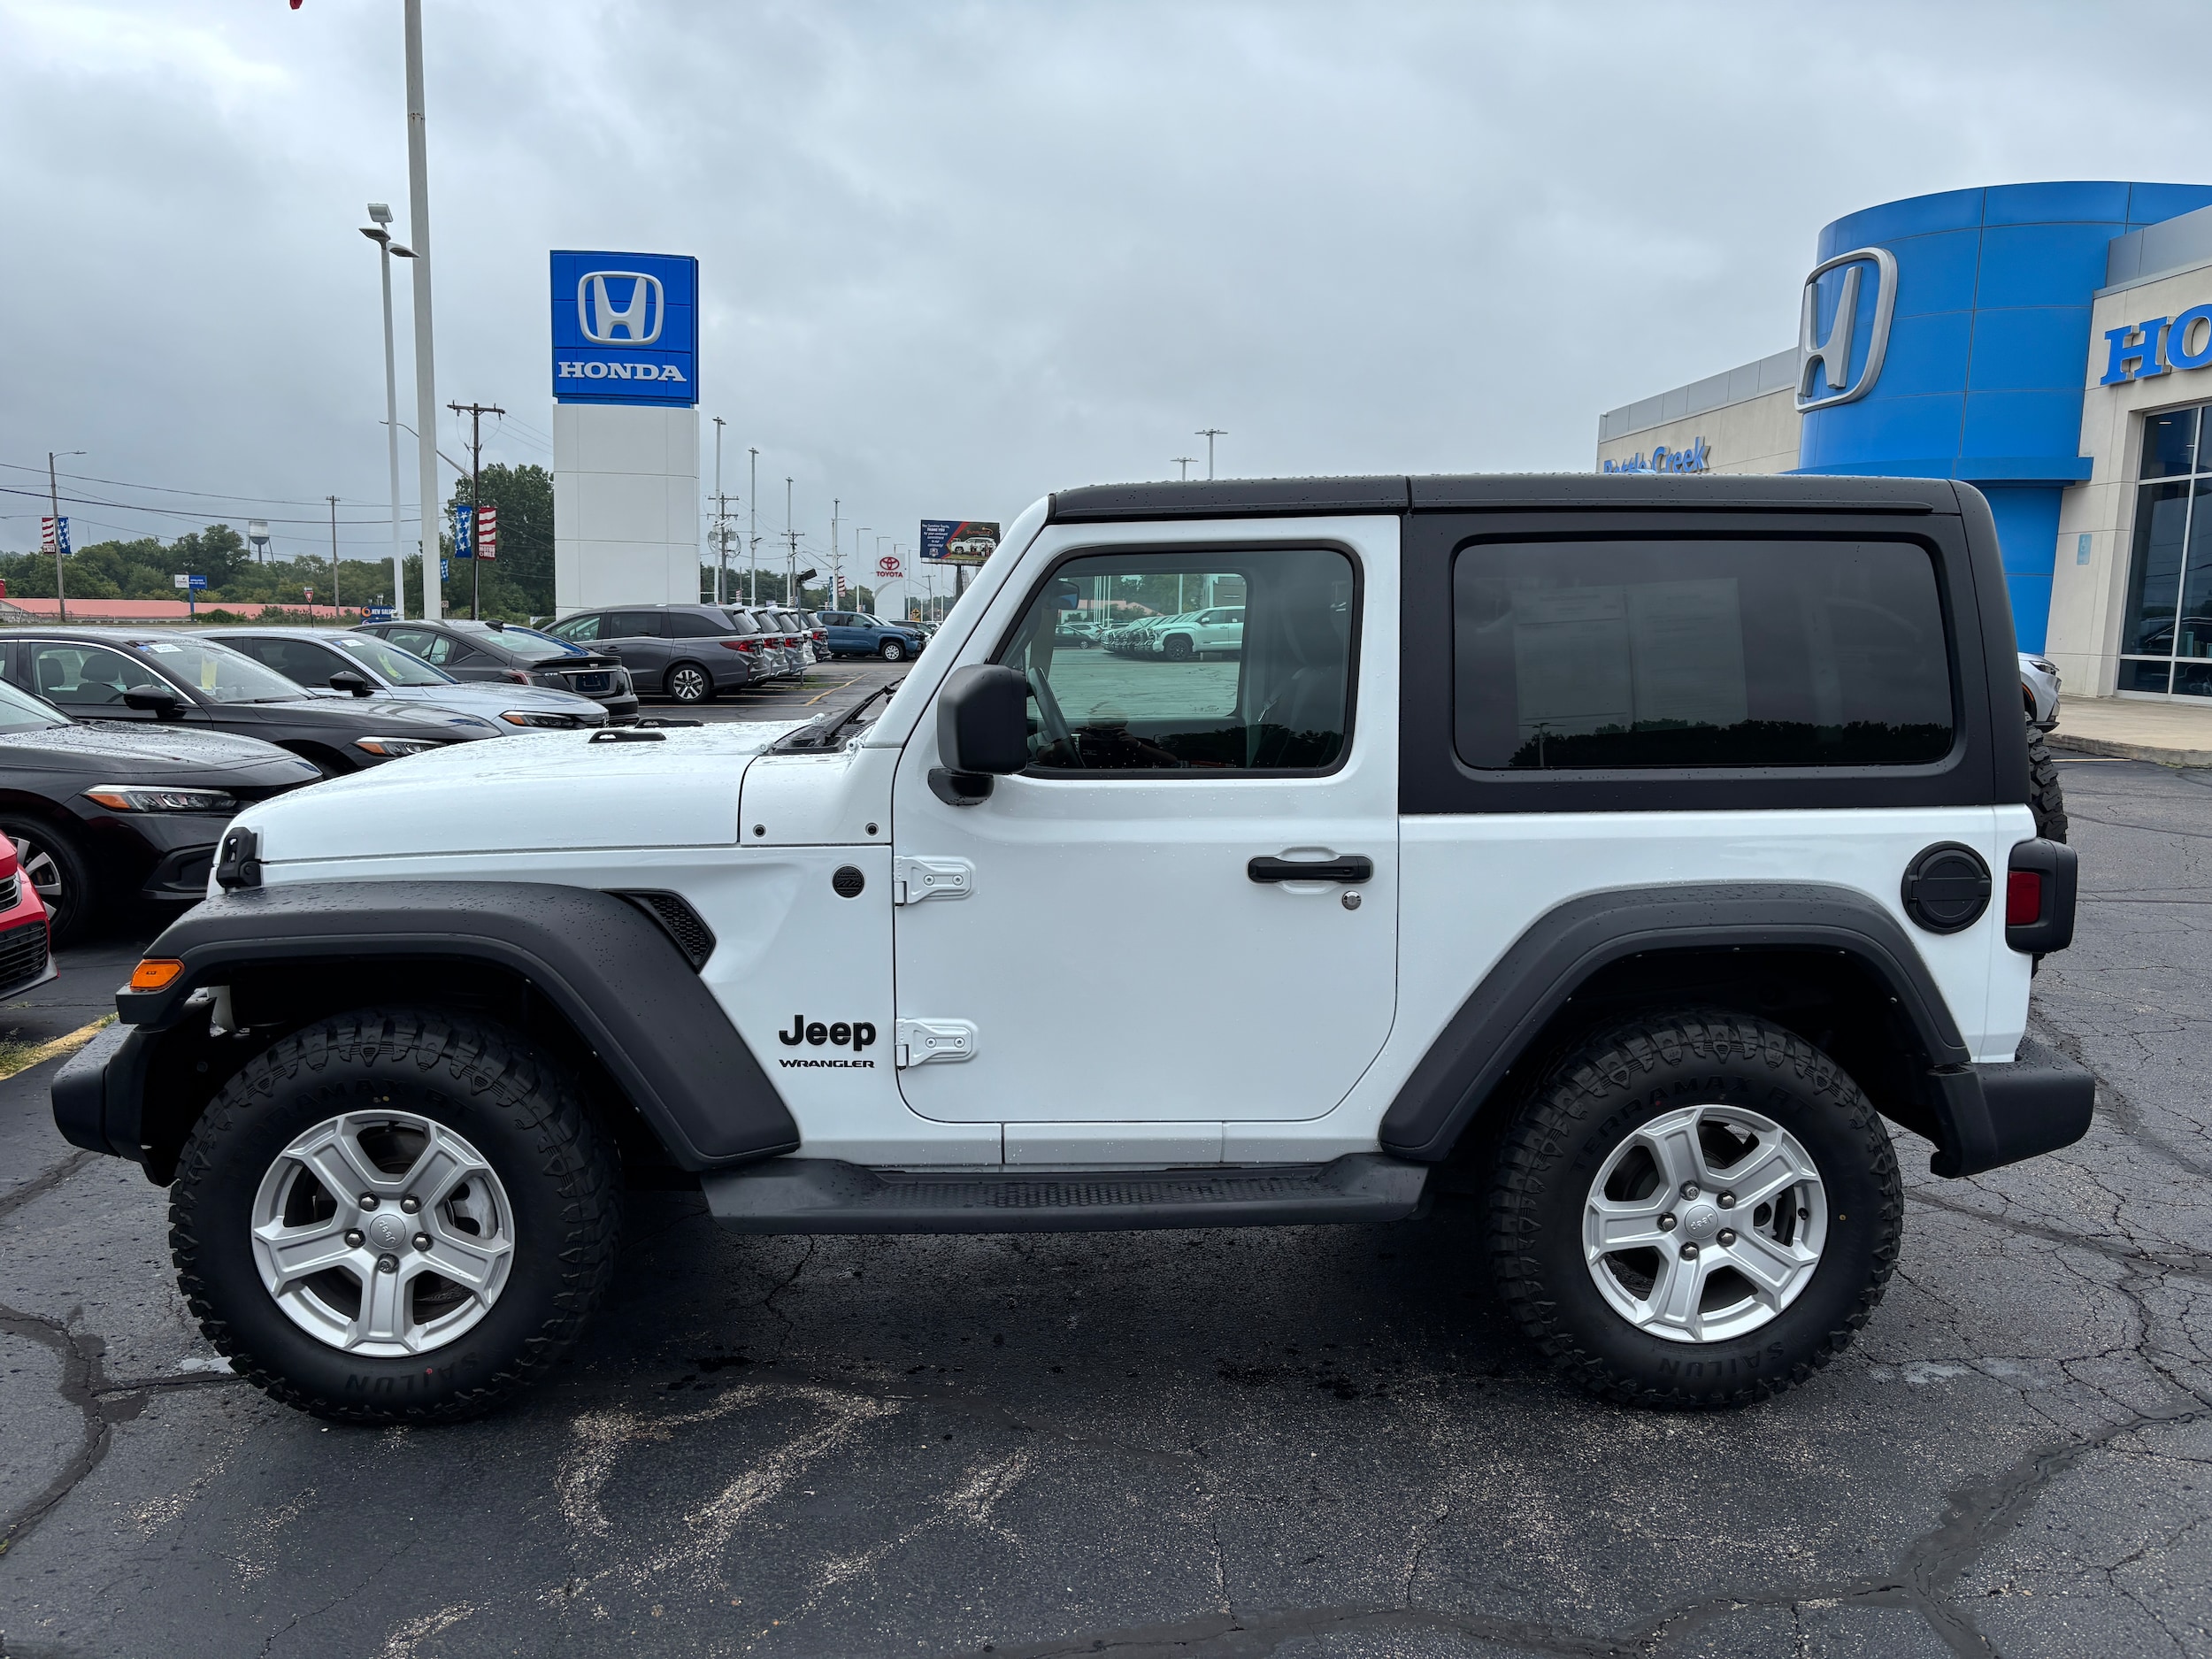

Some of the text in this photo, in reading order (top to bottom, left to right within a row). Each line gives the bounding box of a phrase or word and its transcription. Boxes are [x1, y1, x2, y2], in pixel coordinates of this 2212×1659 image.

[558, 362, 687, 381] HONDA
[1652, 436, 1710, 473] Creek
[779, 1015, 876, 1052] Jeep
[779, 1059, 875, 1069] WRANGLER
[379, 1219, 396, 1243] Jeep
[1690, 1213, 1714, 1231] Jeep
[1657, 1340, 1785, 1378] SAILUN
